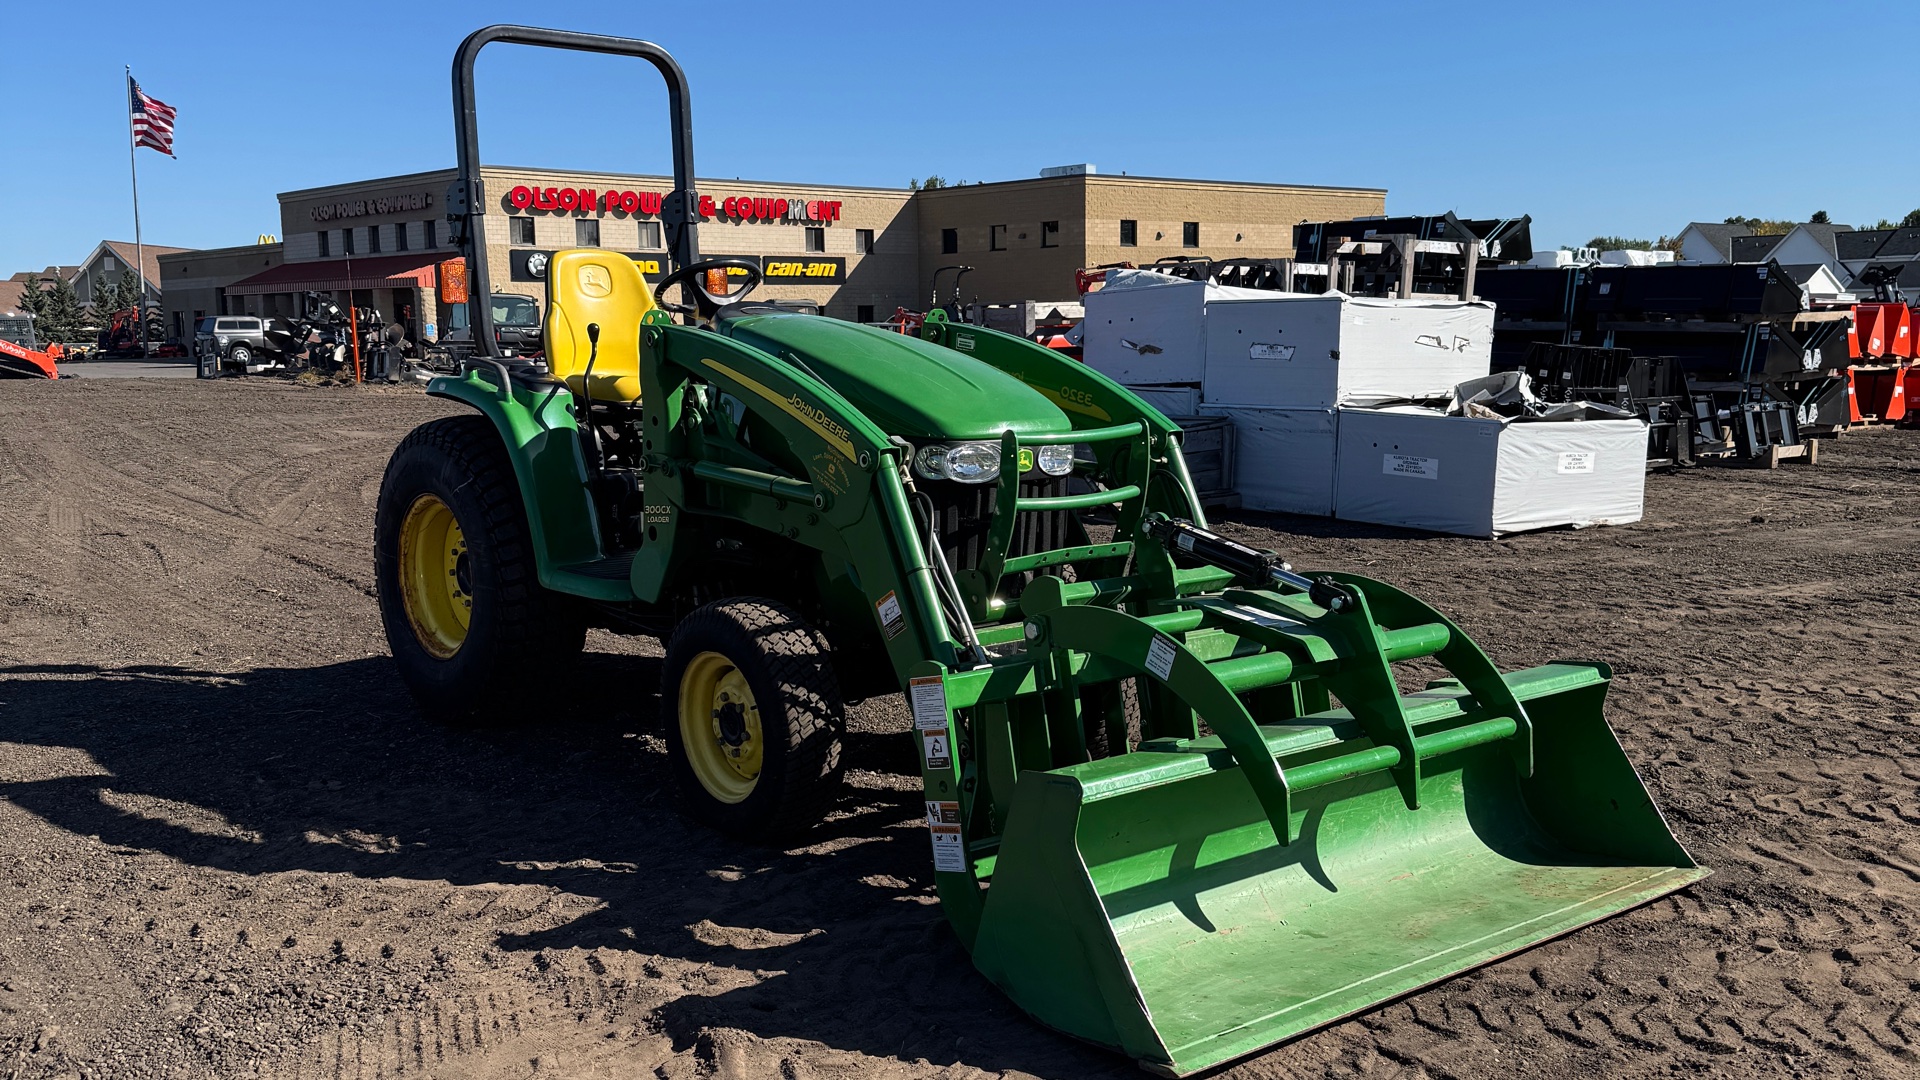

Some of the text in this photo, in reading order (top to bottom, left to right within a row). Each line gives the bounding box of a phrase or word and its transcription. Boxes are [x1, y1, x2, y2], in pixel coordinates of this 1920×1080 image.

[336, 200, 366, 218] POWER
[376, 193, 428, 215] EQUIPMENT
[511, 185, 842, 221] OLSON POW & EQUIPMENT
[766, 262, 837, 277] can-am
[0, 342, 26, 357] Kubota
[787, 393, 850, 442] JOHN DEERE
[645, 505, 671, 514] 300CX
